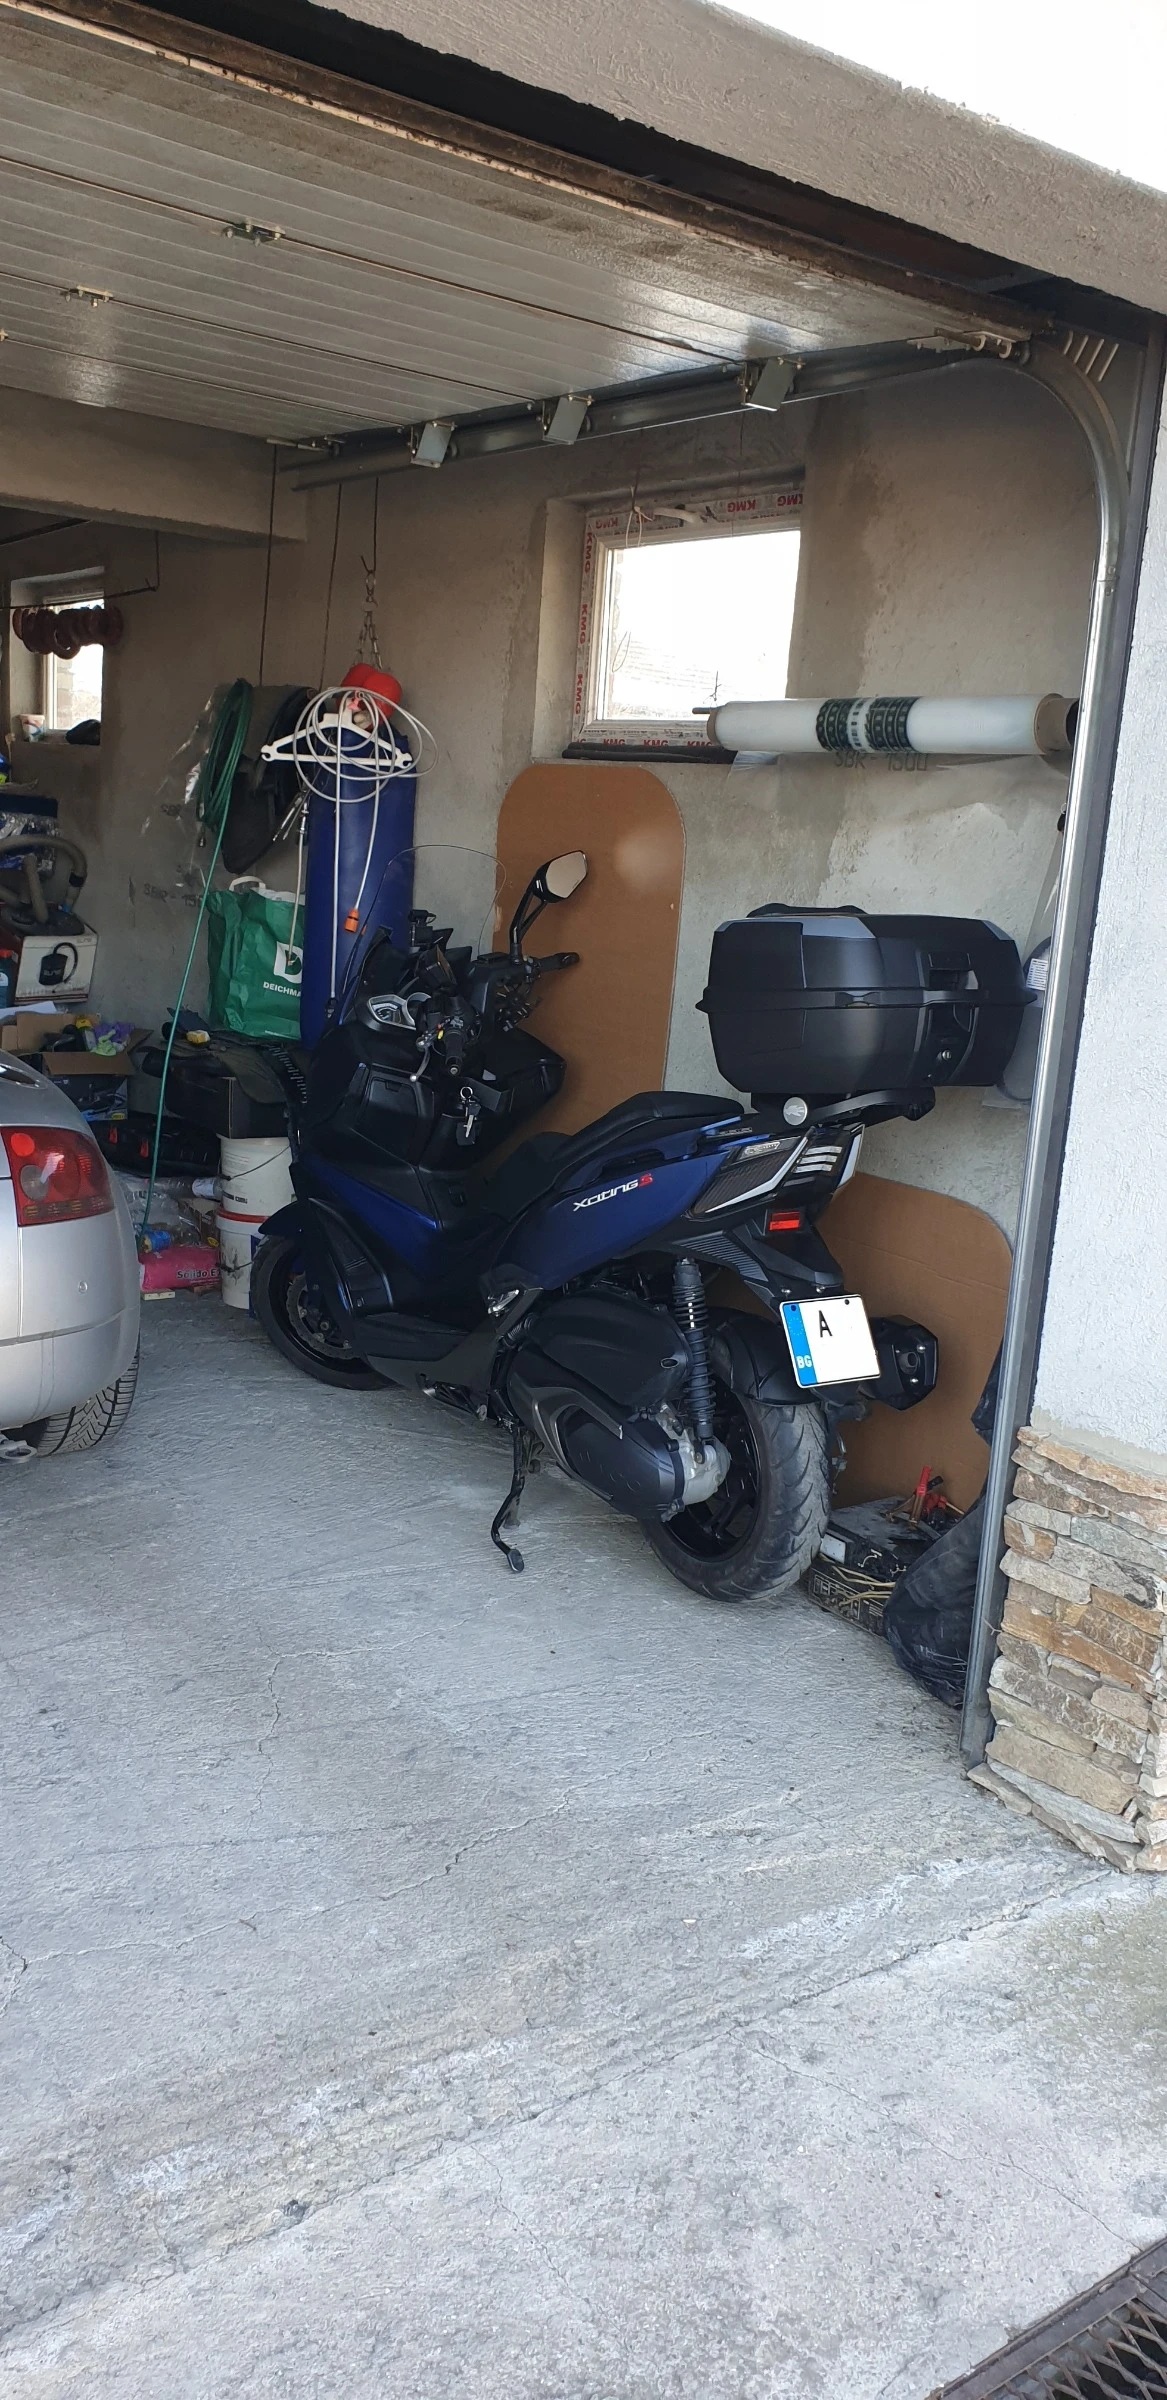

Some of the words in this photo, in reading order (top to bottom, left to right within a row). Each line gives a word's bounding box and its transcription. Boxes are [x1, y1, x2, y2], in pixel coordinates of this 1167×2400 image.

[727, 499, 756, 513] KMG
[584, 532, 593, 574] KMG
[579, 603, 588, 645] KMG
[575, 673, 583, 715] KMG
[818, 1310, 833, 1338] A
[795, 1354, 812, 1369] BG
